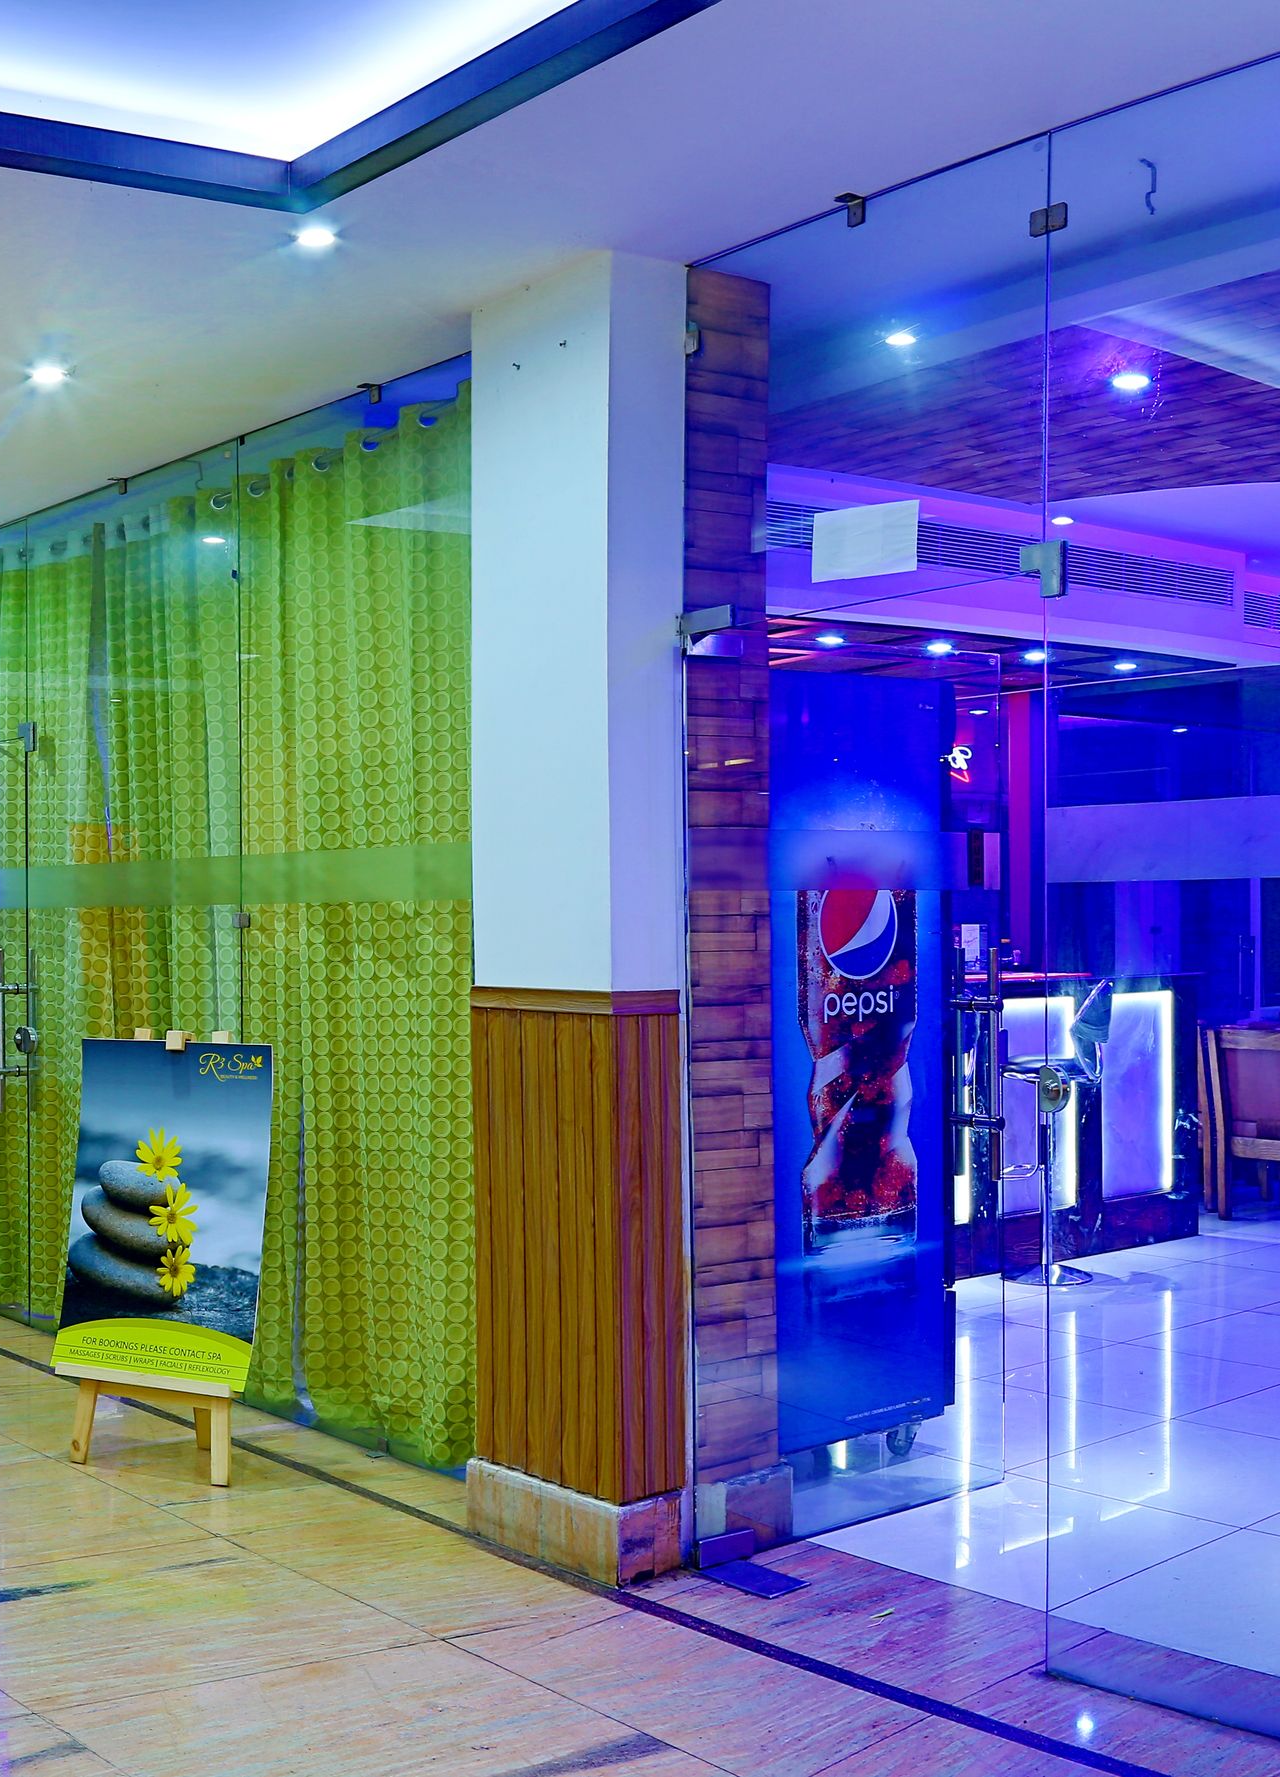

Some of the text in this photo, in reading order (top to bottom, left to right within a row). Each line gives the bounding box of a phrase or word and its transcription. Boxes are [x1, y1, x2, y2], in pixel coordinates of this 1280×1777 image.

[823, 984, 894, 1024] pepsi
[227, 1053, 255, 1075] Spa
[81, 1336, 222, 1361] FOR BOOKINGS PLEASE CONTACT SPA
[69, 1348, 231, 1376] MASSAGES SCRUBS WRAPS FACIALS REFLEXOLOGY
